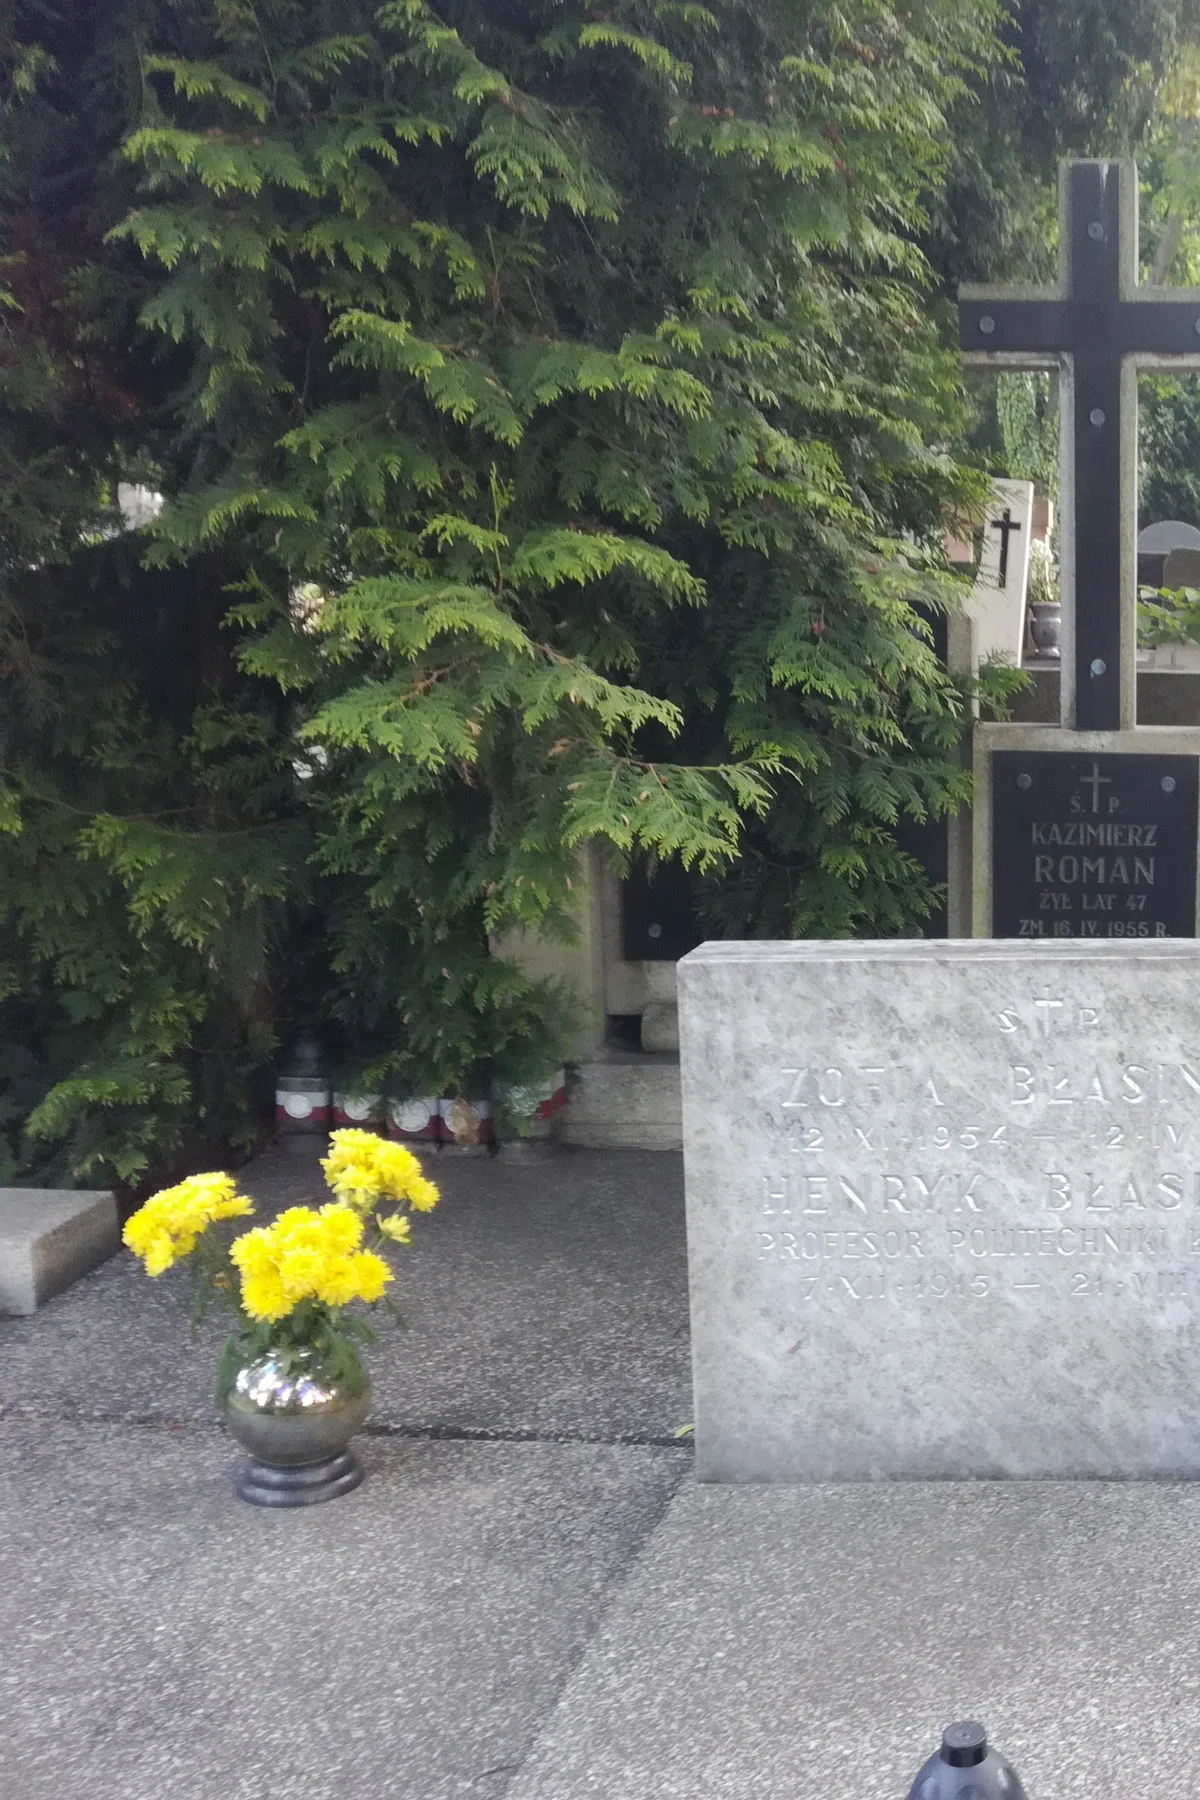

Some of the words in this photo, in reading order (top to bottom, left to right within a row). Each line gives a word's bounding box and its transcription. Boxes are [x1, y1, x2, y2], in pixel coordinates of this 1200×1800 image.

[1031, 822, 1159, 848] KAZIMIERZ
[1034, 855, 1156, 885] ROMAN
[1082, 893, 1117, 910] LAT
[1125, 894, 1148, 911] 47
[1107, 921, 1150, 937] 1955
[780, 1066, 945, 1107] ZOFIA
[761, 1174, 985, 1215] HENRYK
[757, 1229, 927, 1260] PROFESOR
[947, 1227, 1167, 1257] POLITECHNIKI
